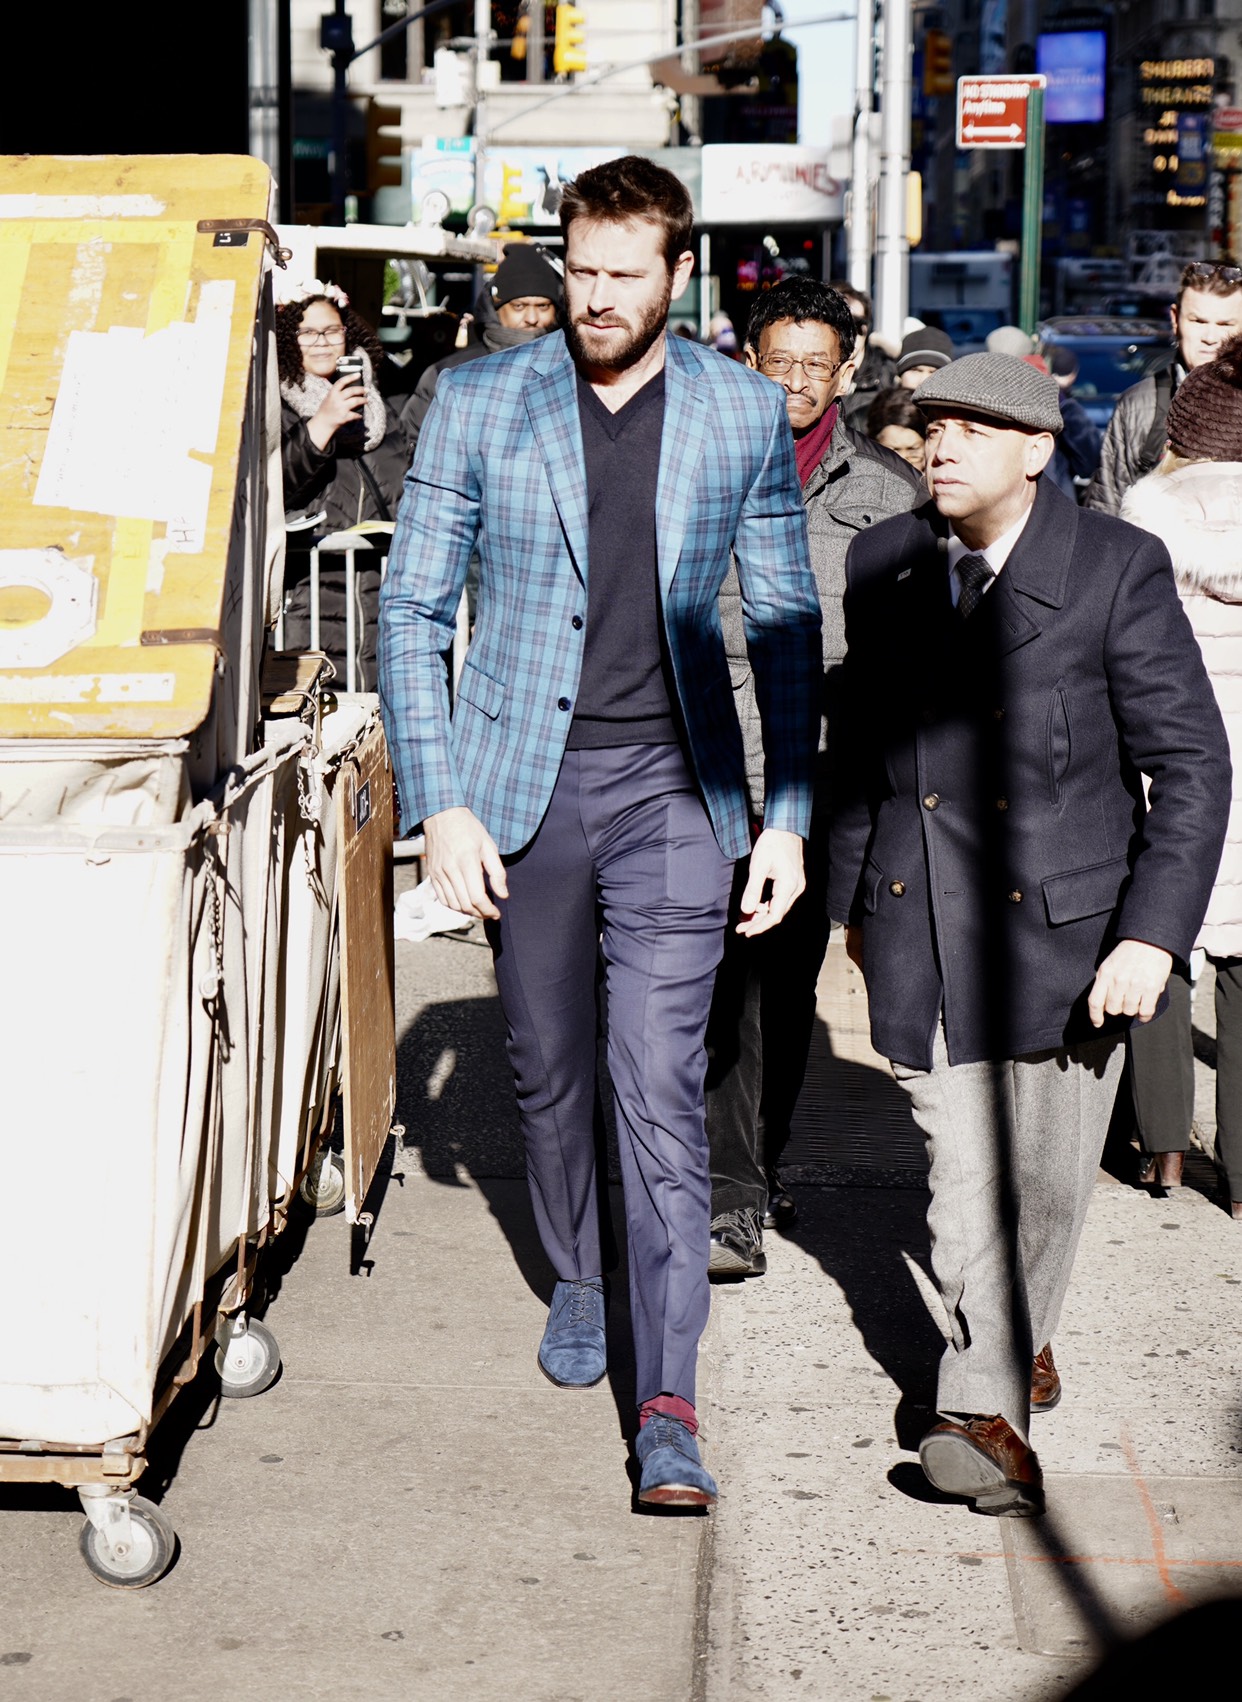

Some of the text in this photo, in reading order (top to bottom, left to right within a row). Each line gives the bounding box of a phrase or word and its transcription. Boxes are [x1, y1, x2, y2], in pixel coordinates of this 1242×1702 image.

[1140, 58, 1214, 79] SHUBERT
[963, 84, 979, 99] NO
[963, 98, 1007, 117] Anytime
